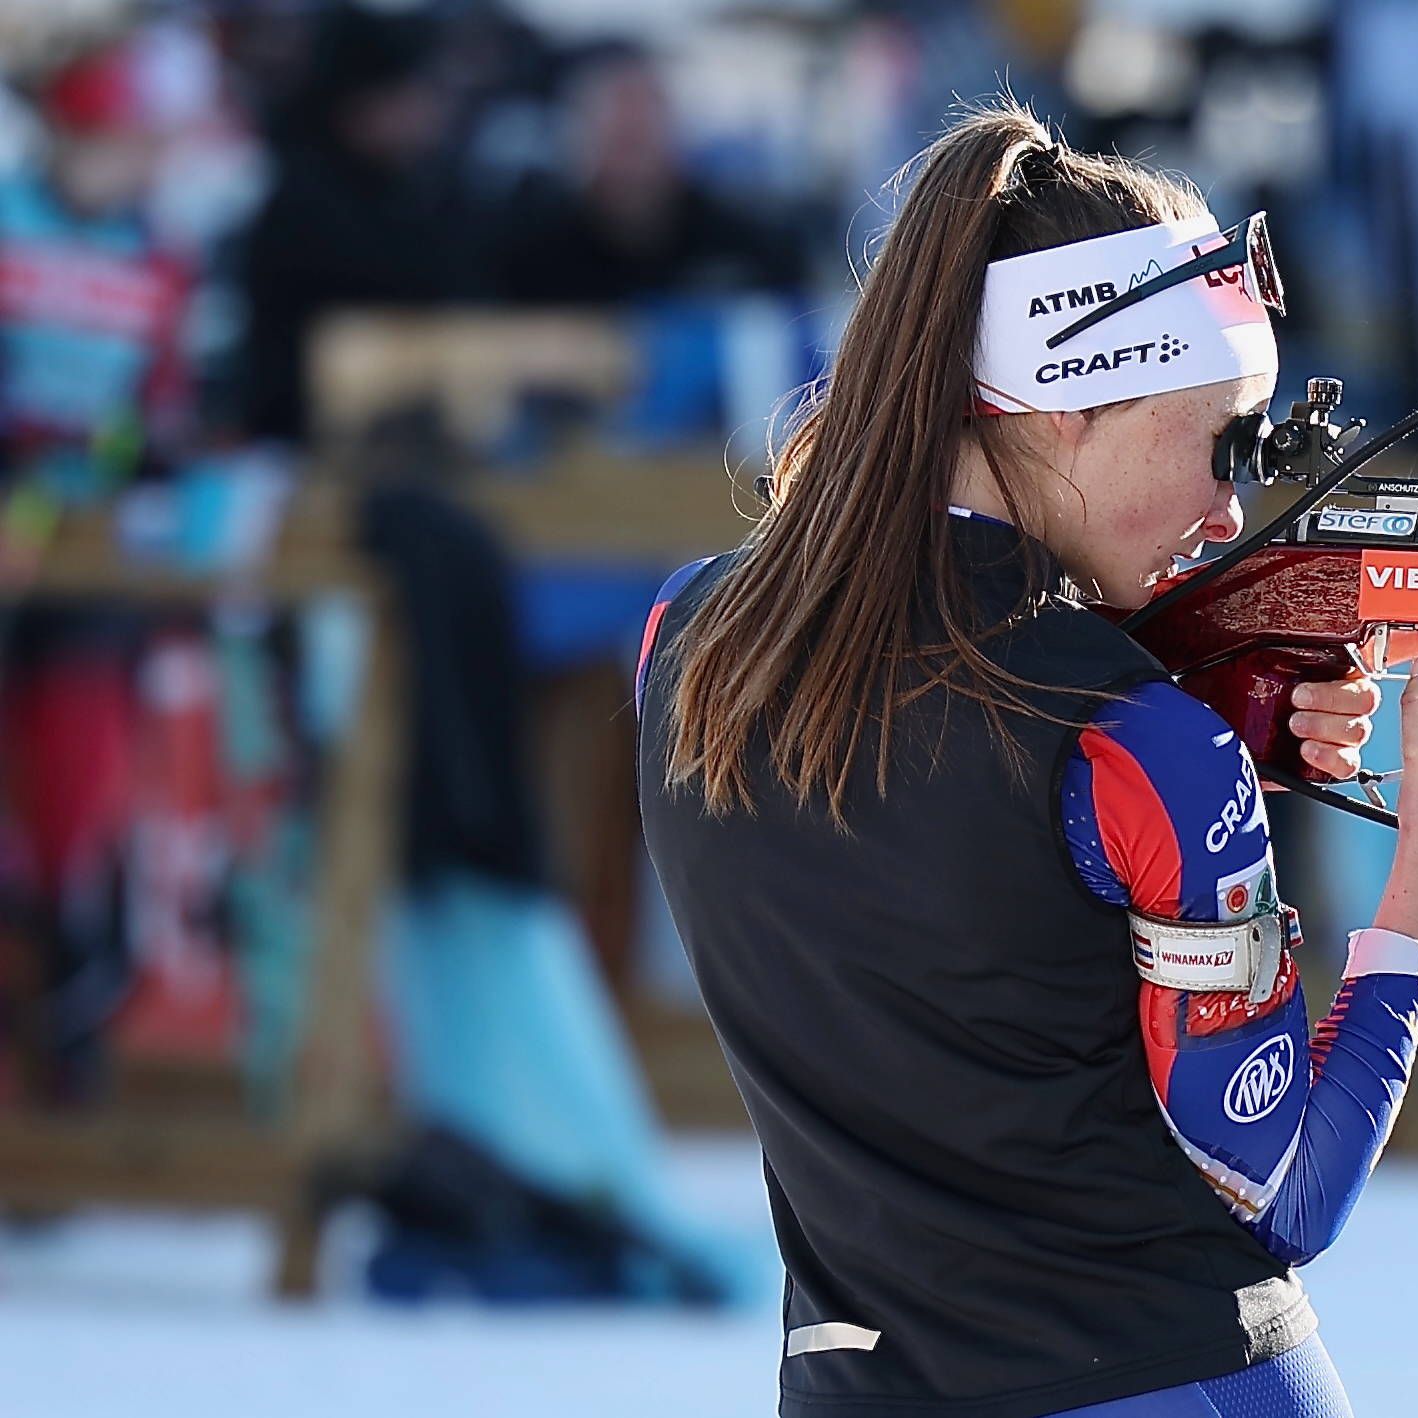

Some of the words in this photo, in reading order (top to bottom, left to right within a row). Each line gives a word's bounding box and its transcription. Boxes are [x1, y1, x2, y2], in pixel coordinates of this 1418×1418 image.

[1028, 281, 1118, 318] ATMB
[1035, 342, 1156, 384] CRAFT
[1161, 951, 1213, 966] WINAMAX
[1215, 951, 1234, 966] TV
